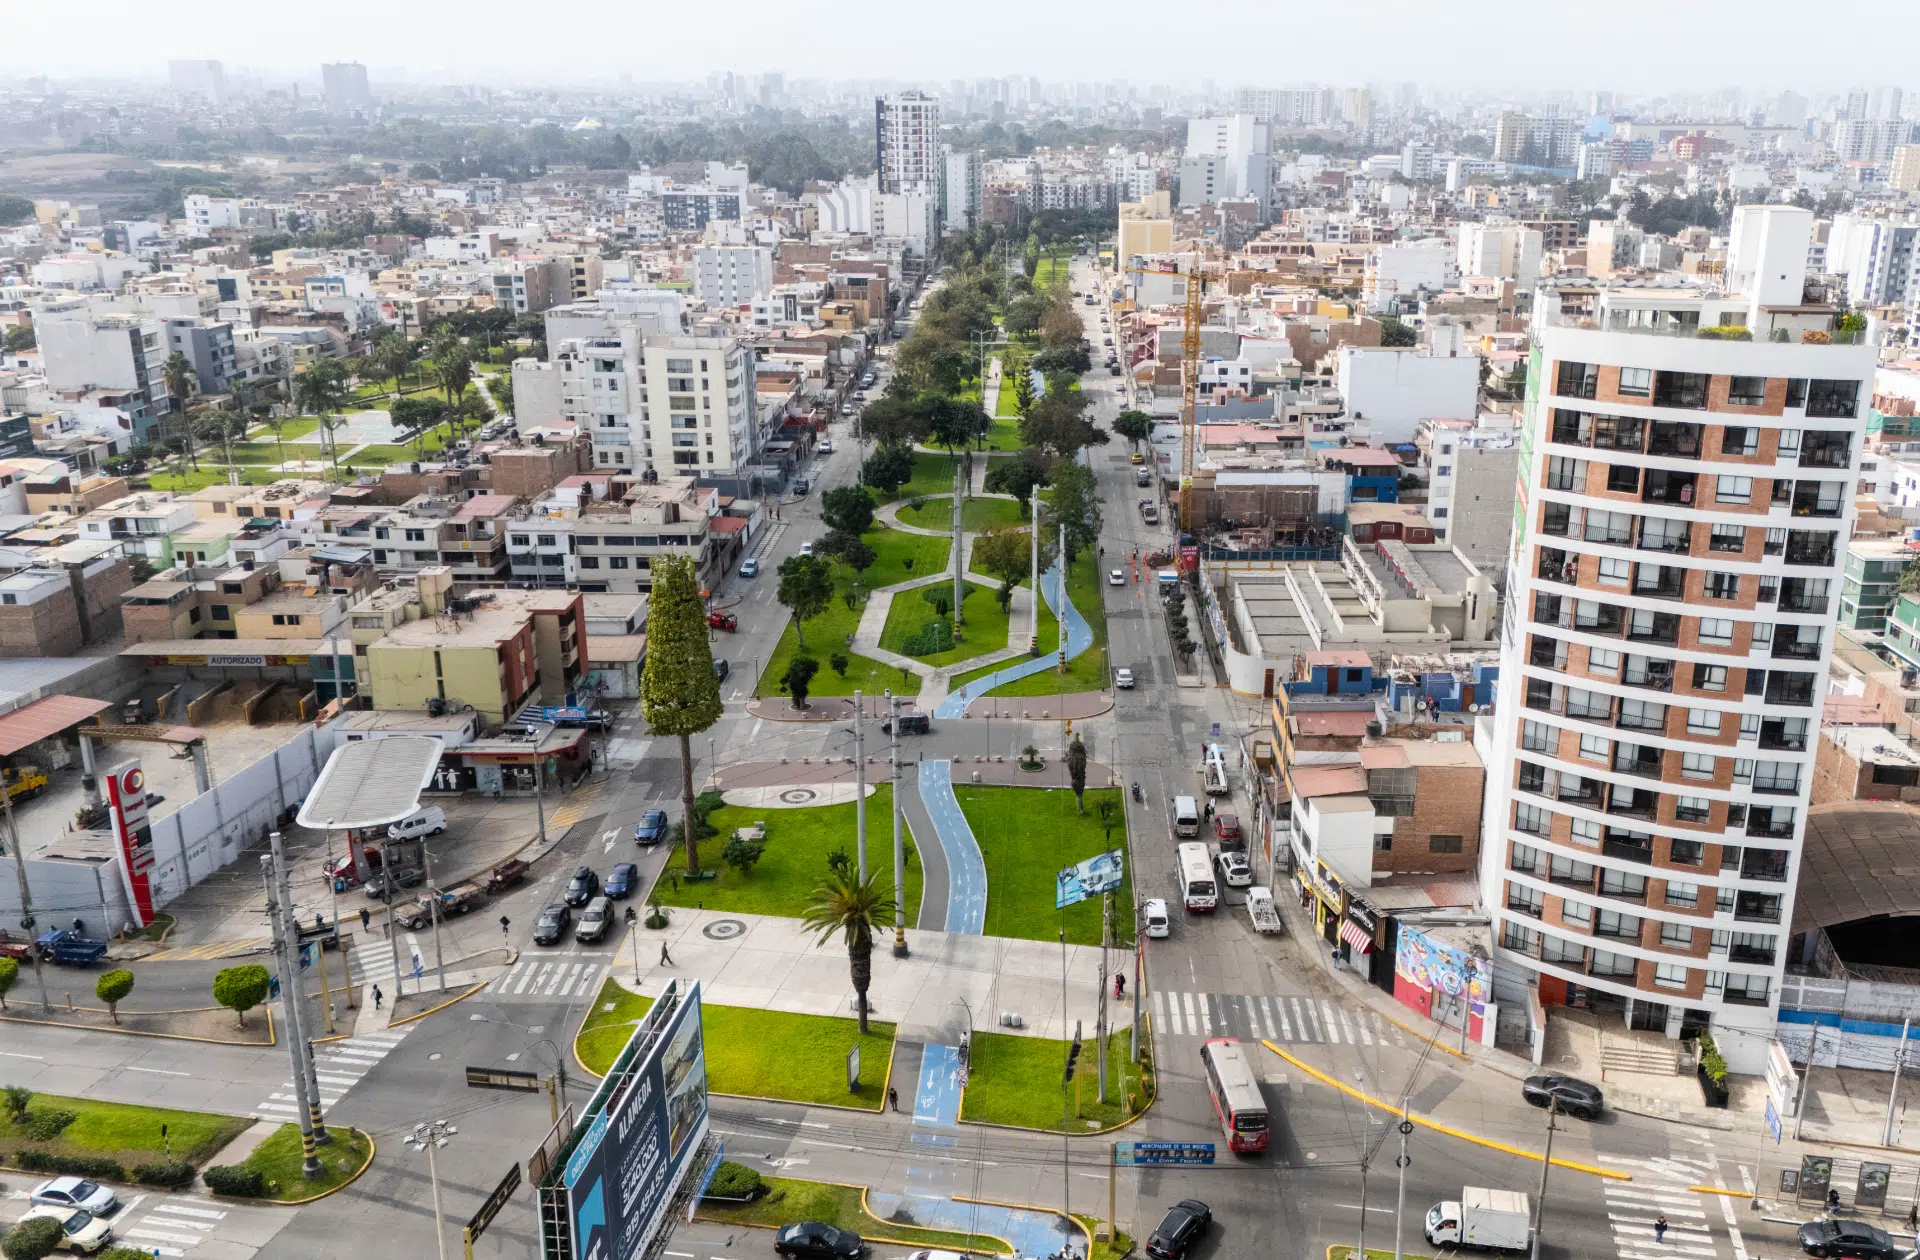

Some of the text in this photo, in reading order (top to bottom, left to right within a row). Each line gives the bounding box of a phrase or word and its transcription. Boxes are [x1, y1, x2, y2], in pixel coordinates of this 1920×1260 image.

[210, 656, 262, 665] AUTORIZADO
[618, 1075, 652, 1144] ALAMEDA
[625, 1210, 640, 1243] 919
[639, 1179, 655, 1217] 454
[654, 1156, 668, 1189] 551
